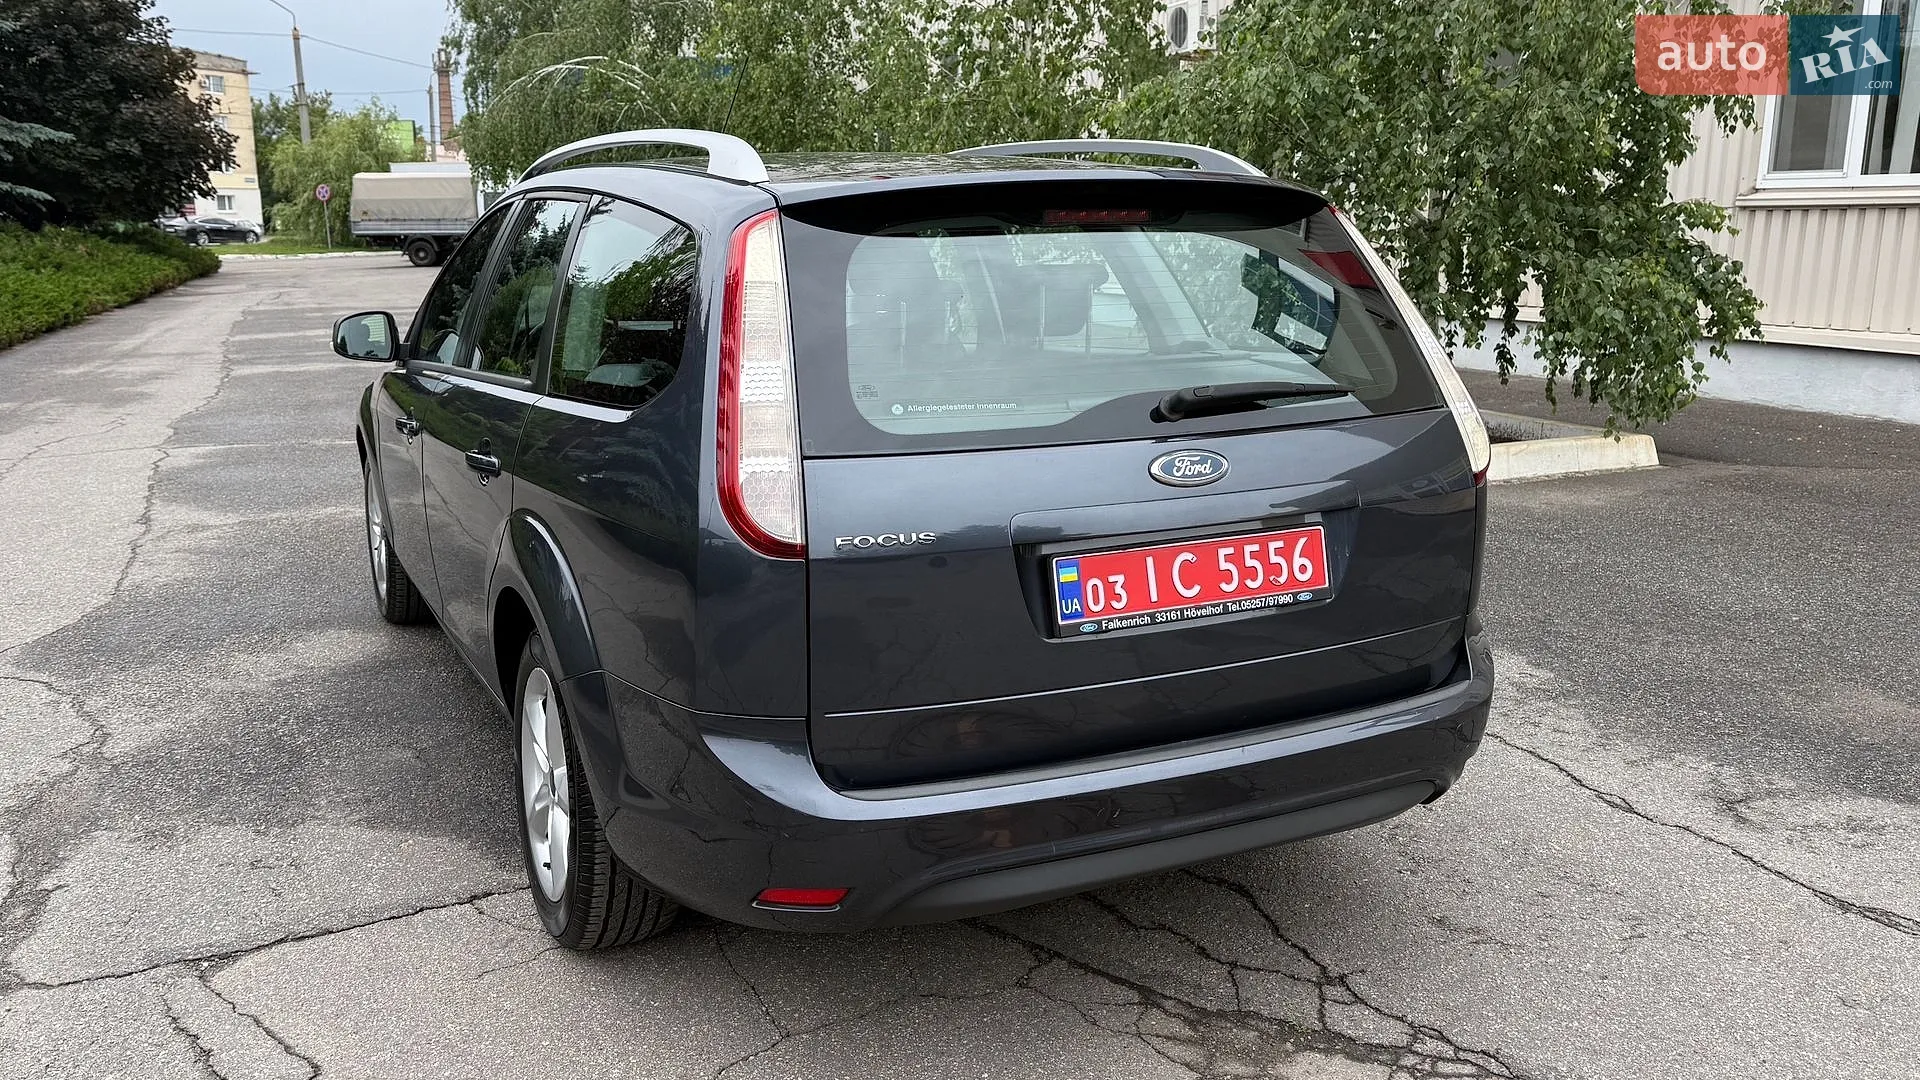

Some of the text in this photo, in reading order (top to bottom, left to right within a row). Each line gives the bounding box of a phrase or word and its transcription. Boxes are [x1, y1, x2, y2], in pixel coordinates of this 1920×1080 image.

[1173, 456, 1212, 476] Ford
[835, 531, 936, 549] FOCUS
[1086, 536, 1313, 613] 03 I C 5556
[1062, 598, 1082, 614] UA
[1101, 615, 1151, 630] Falkenrich
[1155, 610, 1181, 623] 33161
[1184, 603, 1224, 618] Hövelhof
[1226, 594, 1294, 612] Tel.05257/97990
